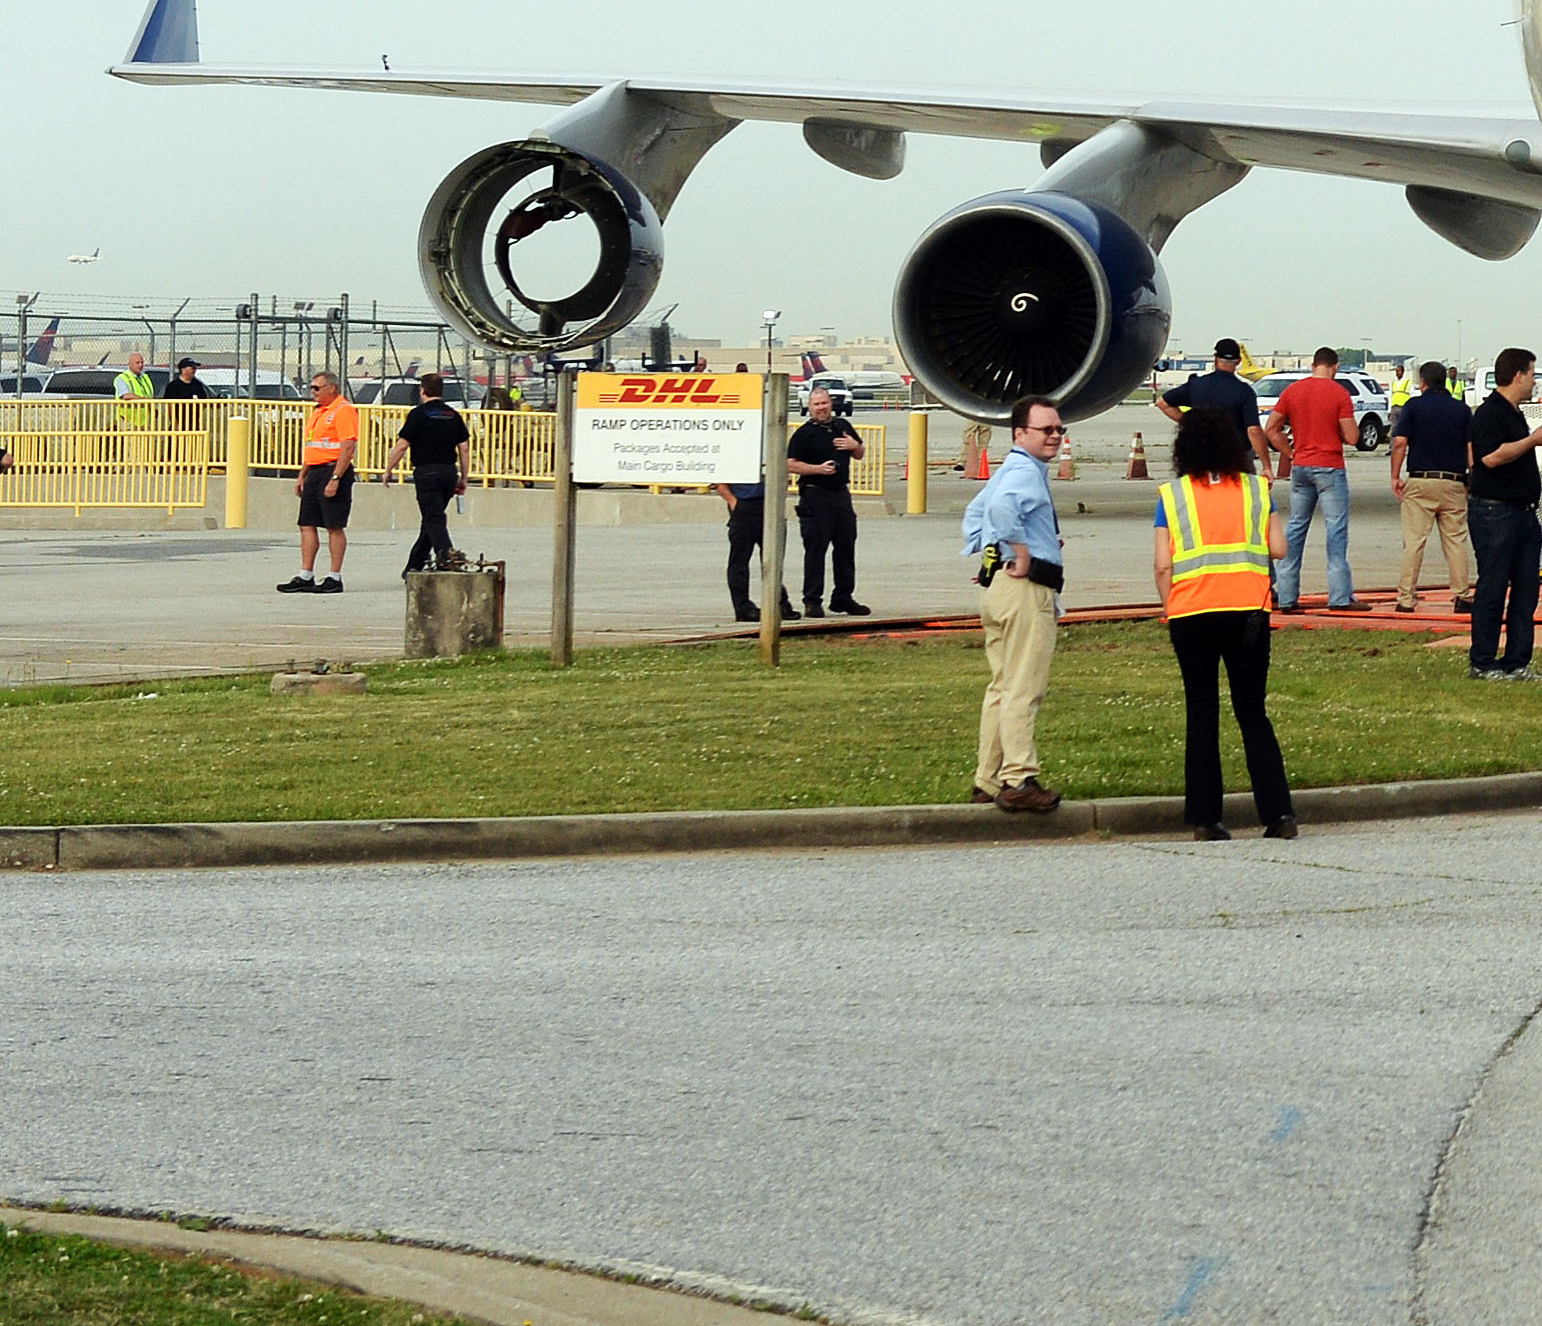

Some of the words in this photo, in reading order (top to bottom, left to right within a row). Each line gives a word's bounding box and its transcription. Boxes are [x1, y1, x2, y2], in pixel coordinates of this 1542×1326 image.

[618, 378, 721, 403] DHL
[592, 419, 627, 431] RAMP
[630, 419, 709, 431] OPERATIONS
[712, 419, 745, 431] ONLY
[614, 442, 660, 456] Packages
[663, 443, 709, 456] Accepted
[711, 444, 720, 454] at
[618, 461, 641, 471] Main
[643, 461, 673, 473] Cargo
[676, 461, 716, 474] Building
